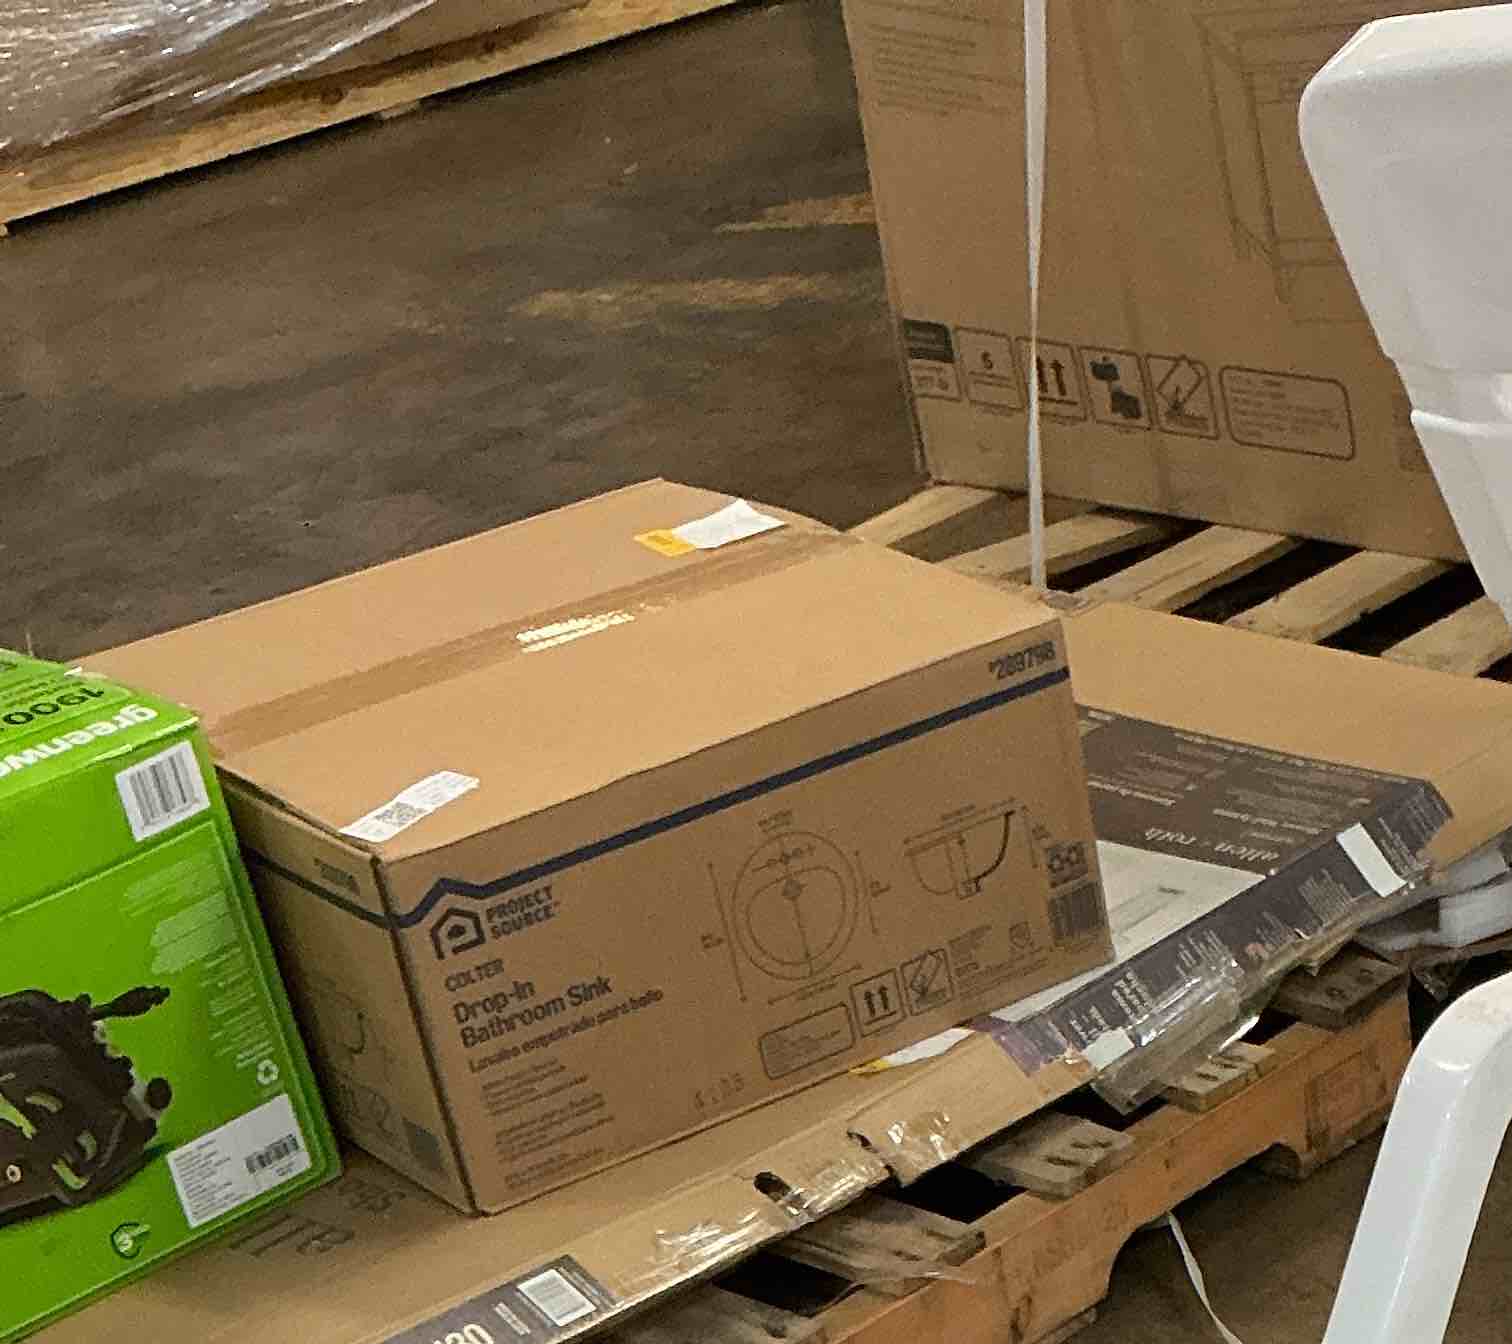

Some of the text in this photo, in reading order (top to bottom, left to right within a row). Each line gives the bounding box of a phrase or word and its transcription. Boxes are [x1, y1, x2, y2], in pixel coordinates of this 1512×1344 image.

[486, 886, 552, 923] PROJECT
[491, 905, 553, 939] SOURCE
[445, 959, 505, 991] COLTER
[453, 979, 536, 1024] Drop-In
[460, 975, 613, 1048] Bathroom Sink
